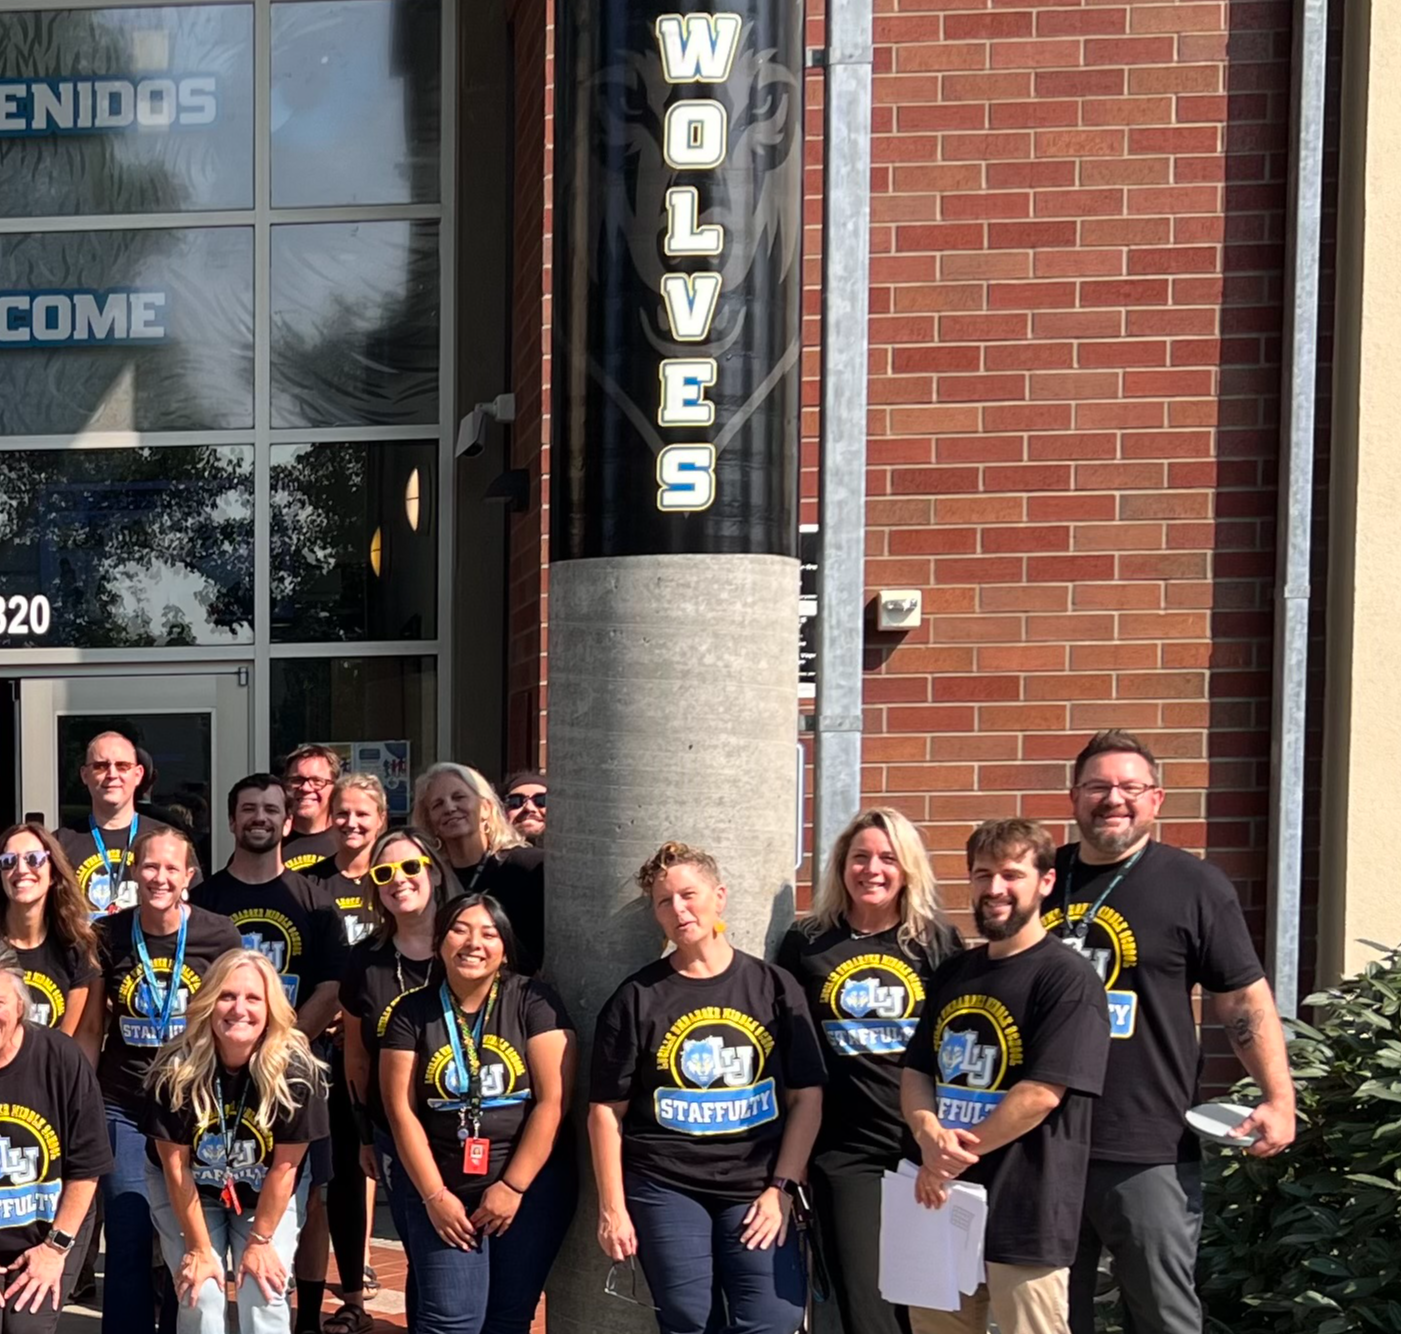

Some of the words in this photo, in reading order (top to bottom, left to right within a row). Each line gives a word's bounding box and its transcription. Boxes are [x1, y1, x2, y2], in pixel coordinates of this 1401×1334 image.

[656, 12, 741, 513] WOLVES
[867, 977, 905, 1018] LU
[708, 1036, 754, 1087] LU
[960, 1029, 998, 1089] LU
[11, 1104, 46, 1130] MIDDLE
[41, 1124, 61, 1160] SCHOOL
[660, 1090, 770, 1123] STAFFULTY
